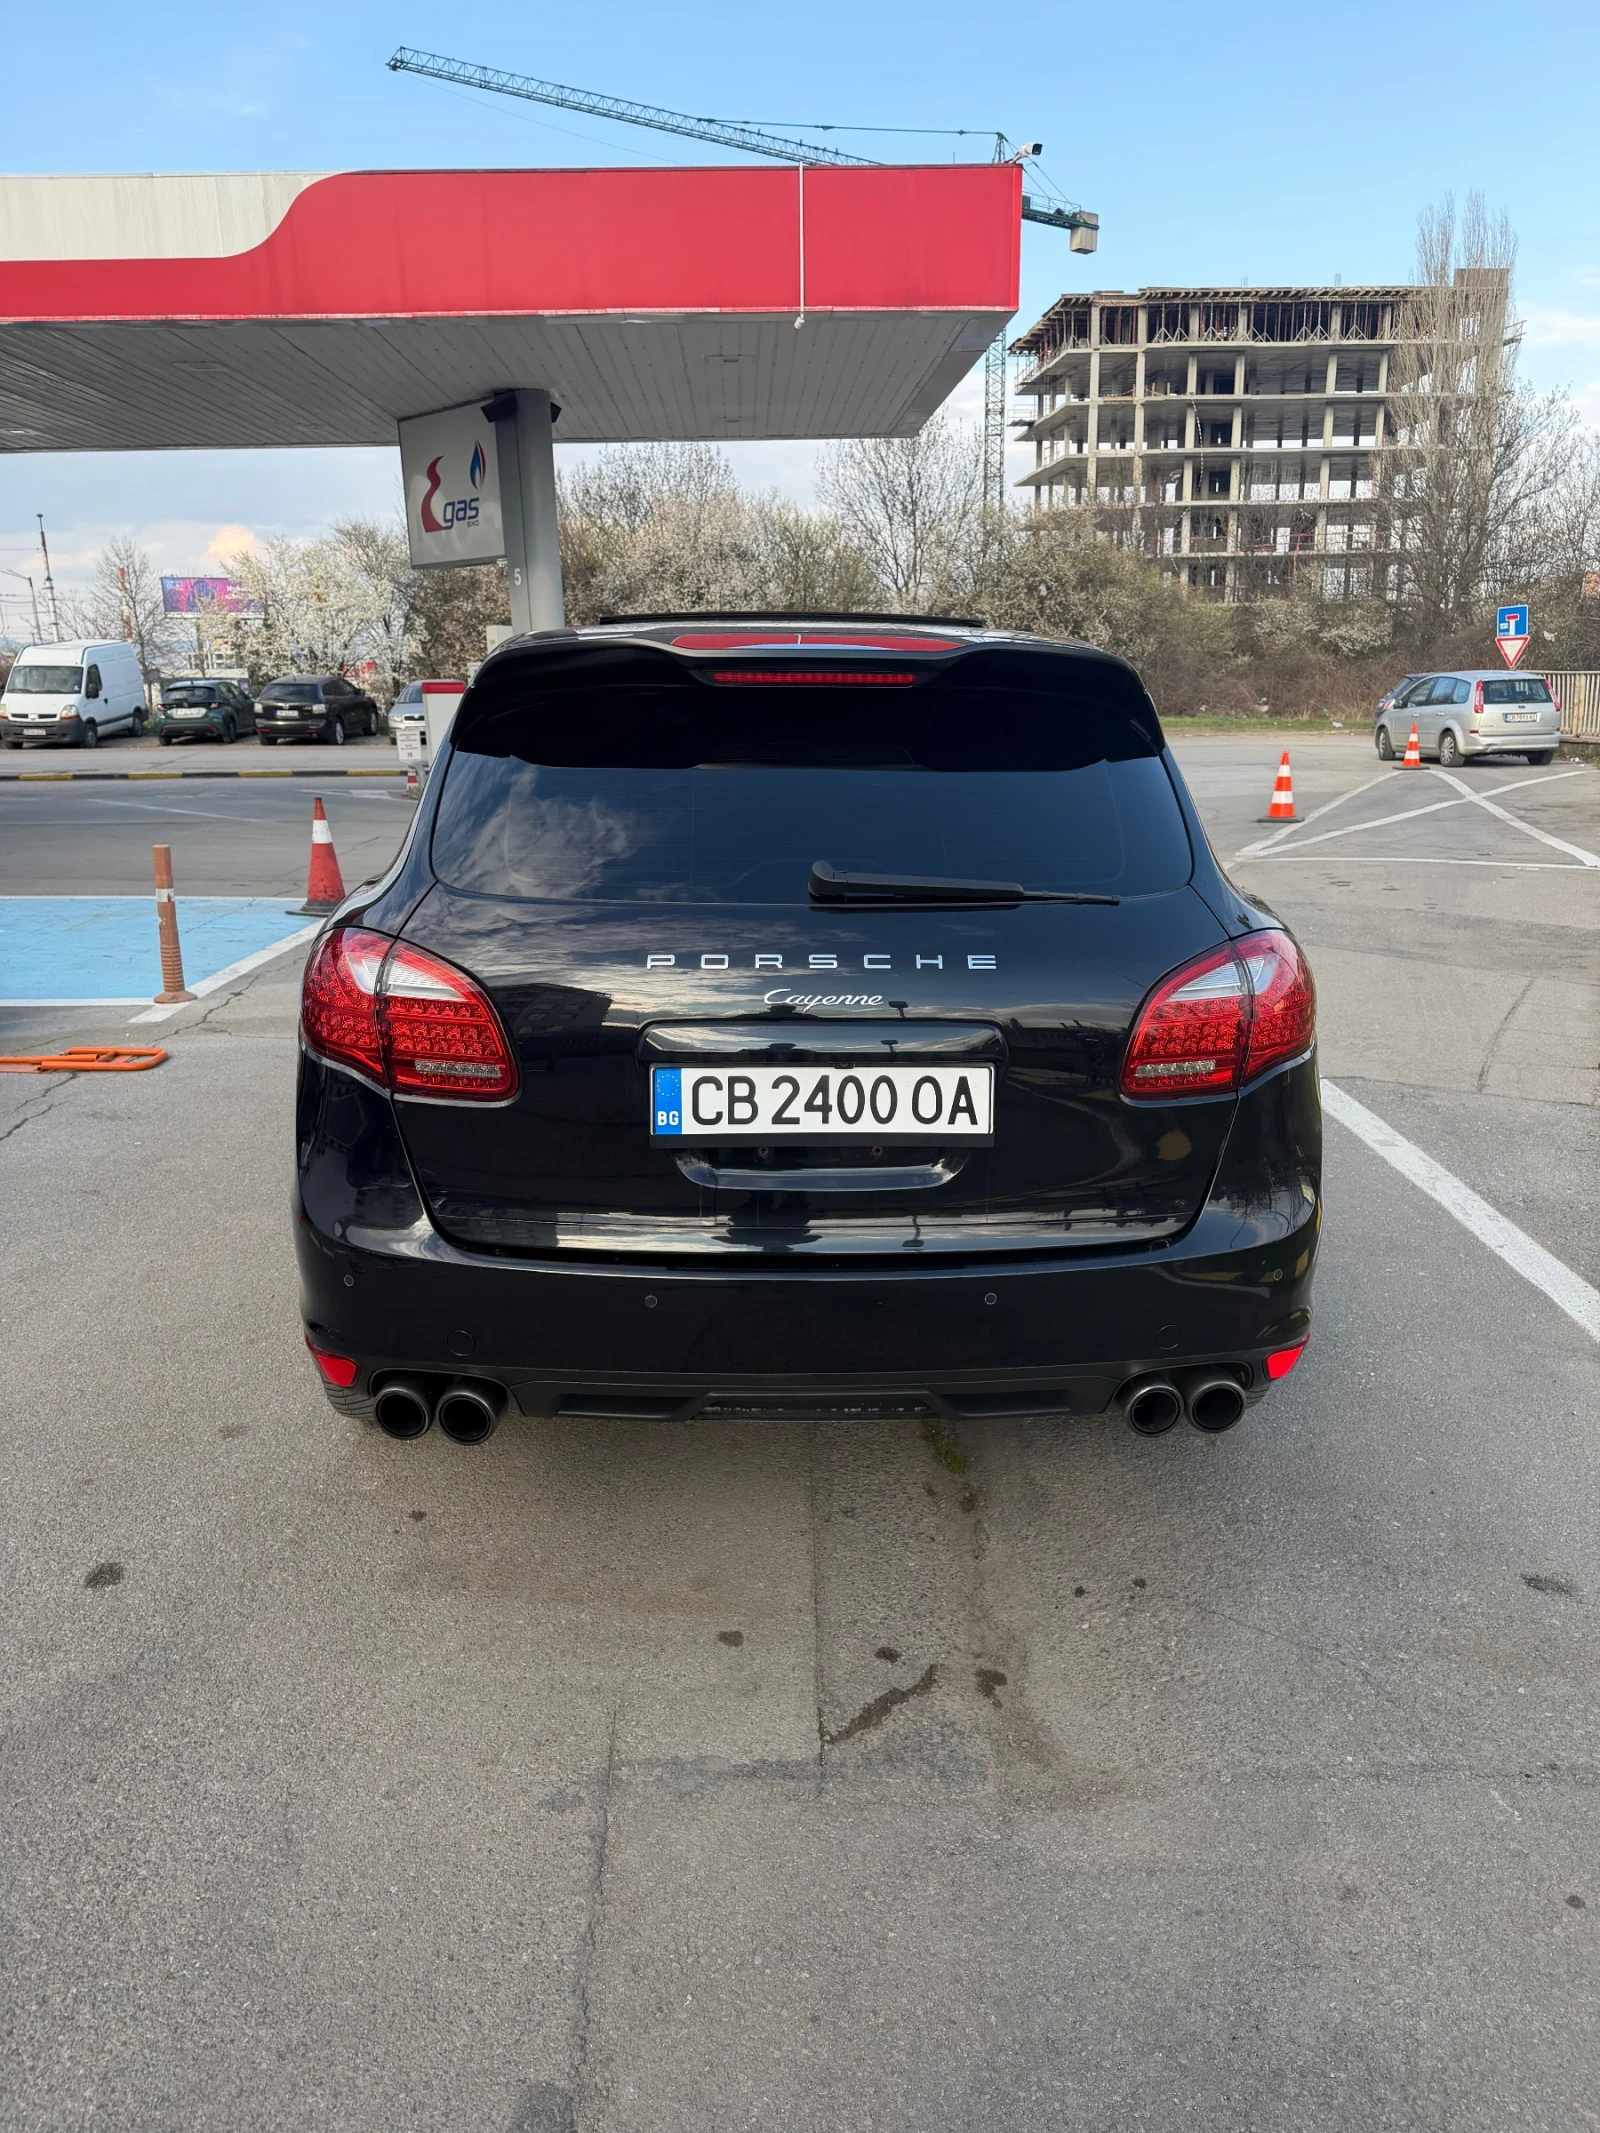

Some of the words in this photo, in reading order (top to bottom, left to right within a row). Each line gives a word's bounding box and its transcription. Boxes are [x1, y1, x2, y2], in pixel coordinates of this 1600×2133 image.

[514, 568, 522, 586] 5
[646, 954, 998, 970] PORSCHE
[763, 988, 885, 1014] Cayenne
[657, 1111, 680, 1126] BG
